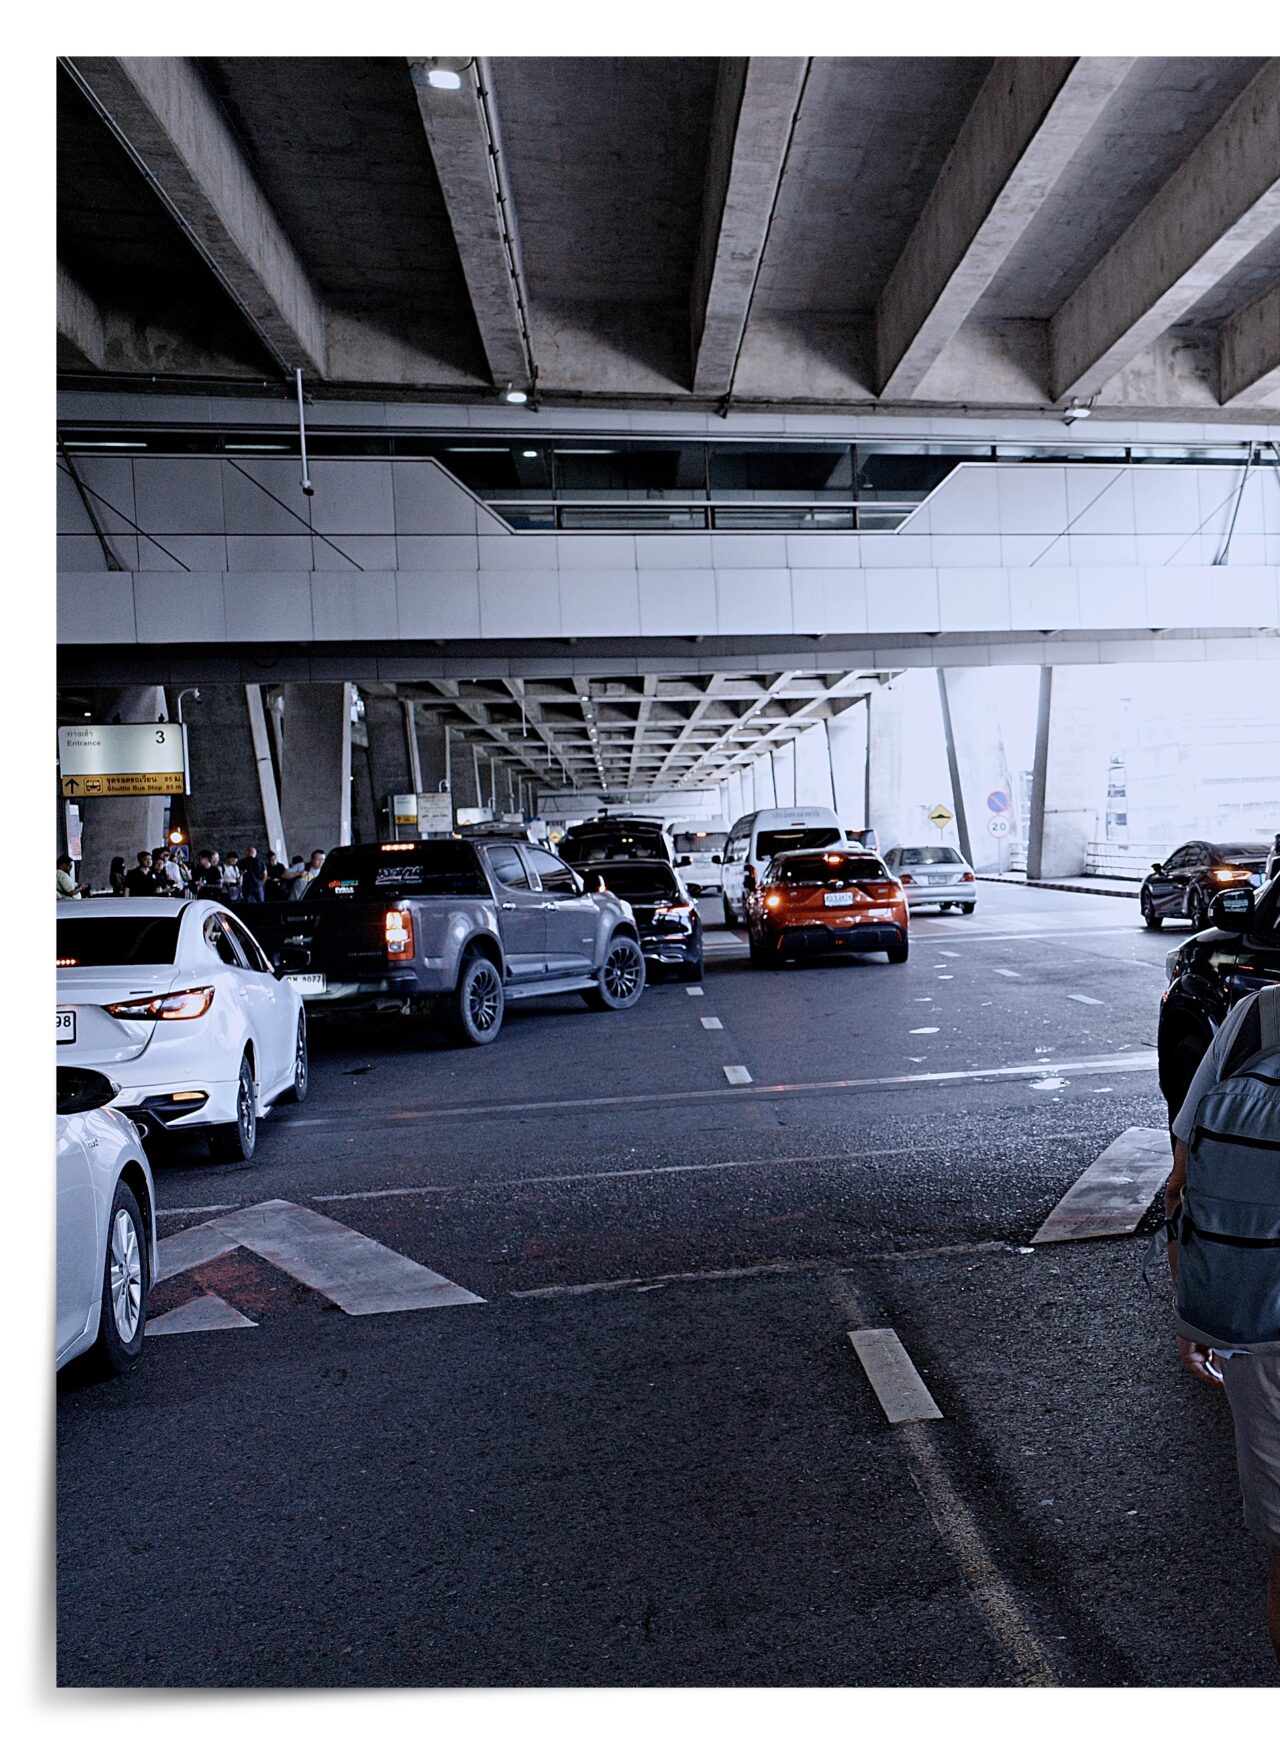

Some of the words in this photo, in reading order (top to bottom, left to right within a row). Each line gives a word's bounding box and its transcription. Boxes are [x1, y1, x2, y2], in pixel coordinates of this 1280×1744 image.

[155, 730, 165, 744] 3
[147, 784, 163, 792] Stop
[992, 823, 1007, 831] 20
